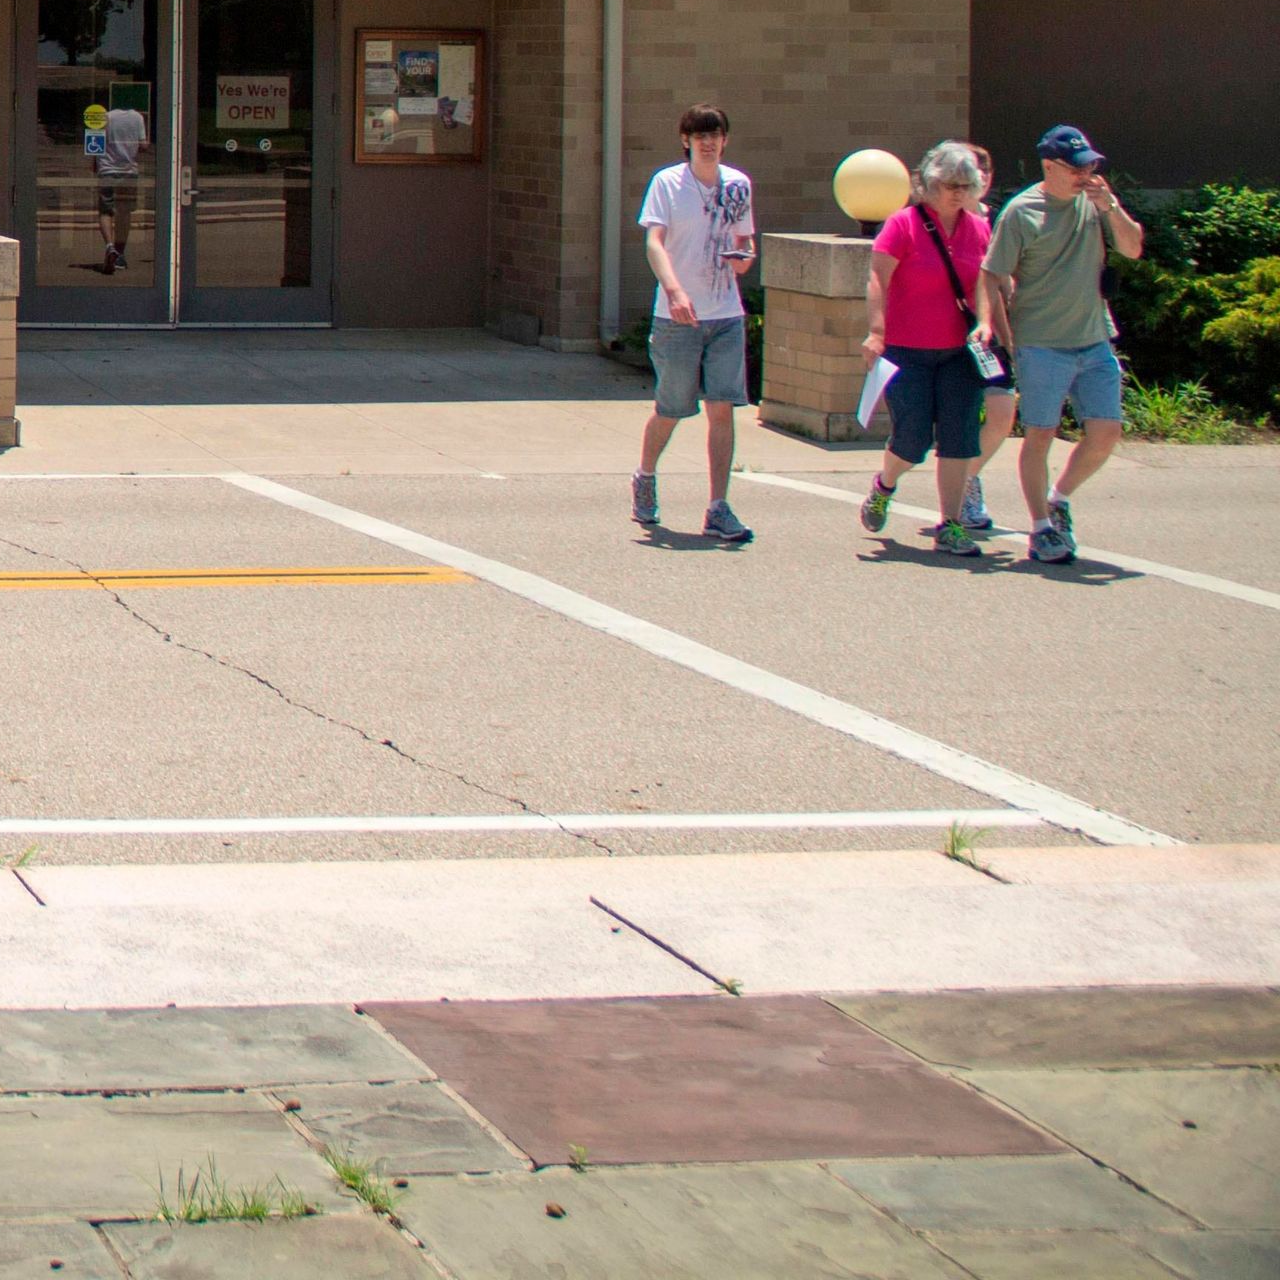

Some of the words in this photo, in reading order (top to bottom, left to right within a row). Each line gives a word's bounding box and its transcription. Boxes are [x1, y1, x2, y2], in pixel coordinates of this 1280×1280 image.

[406, 66, 432, 75] YOUR
[218, 84, 242, 96] Yes
[247, 84, 287, 96] We're
[228, 105, 276, 120] OPEN
